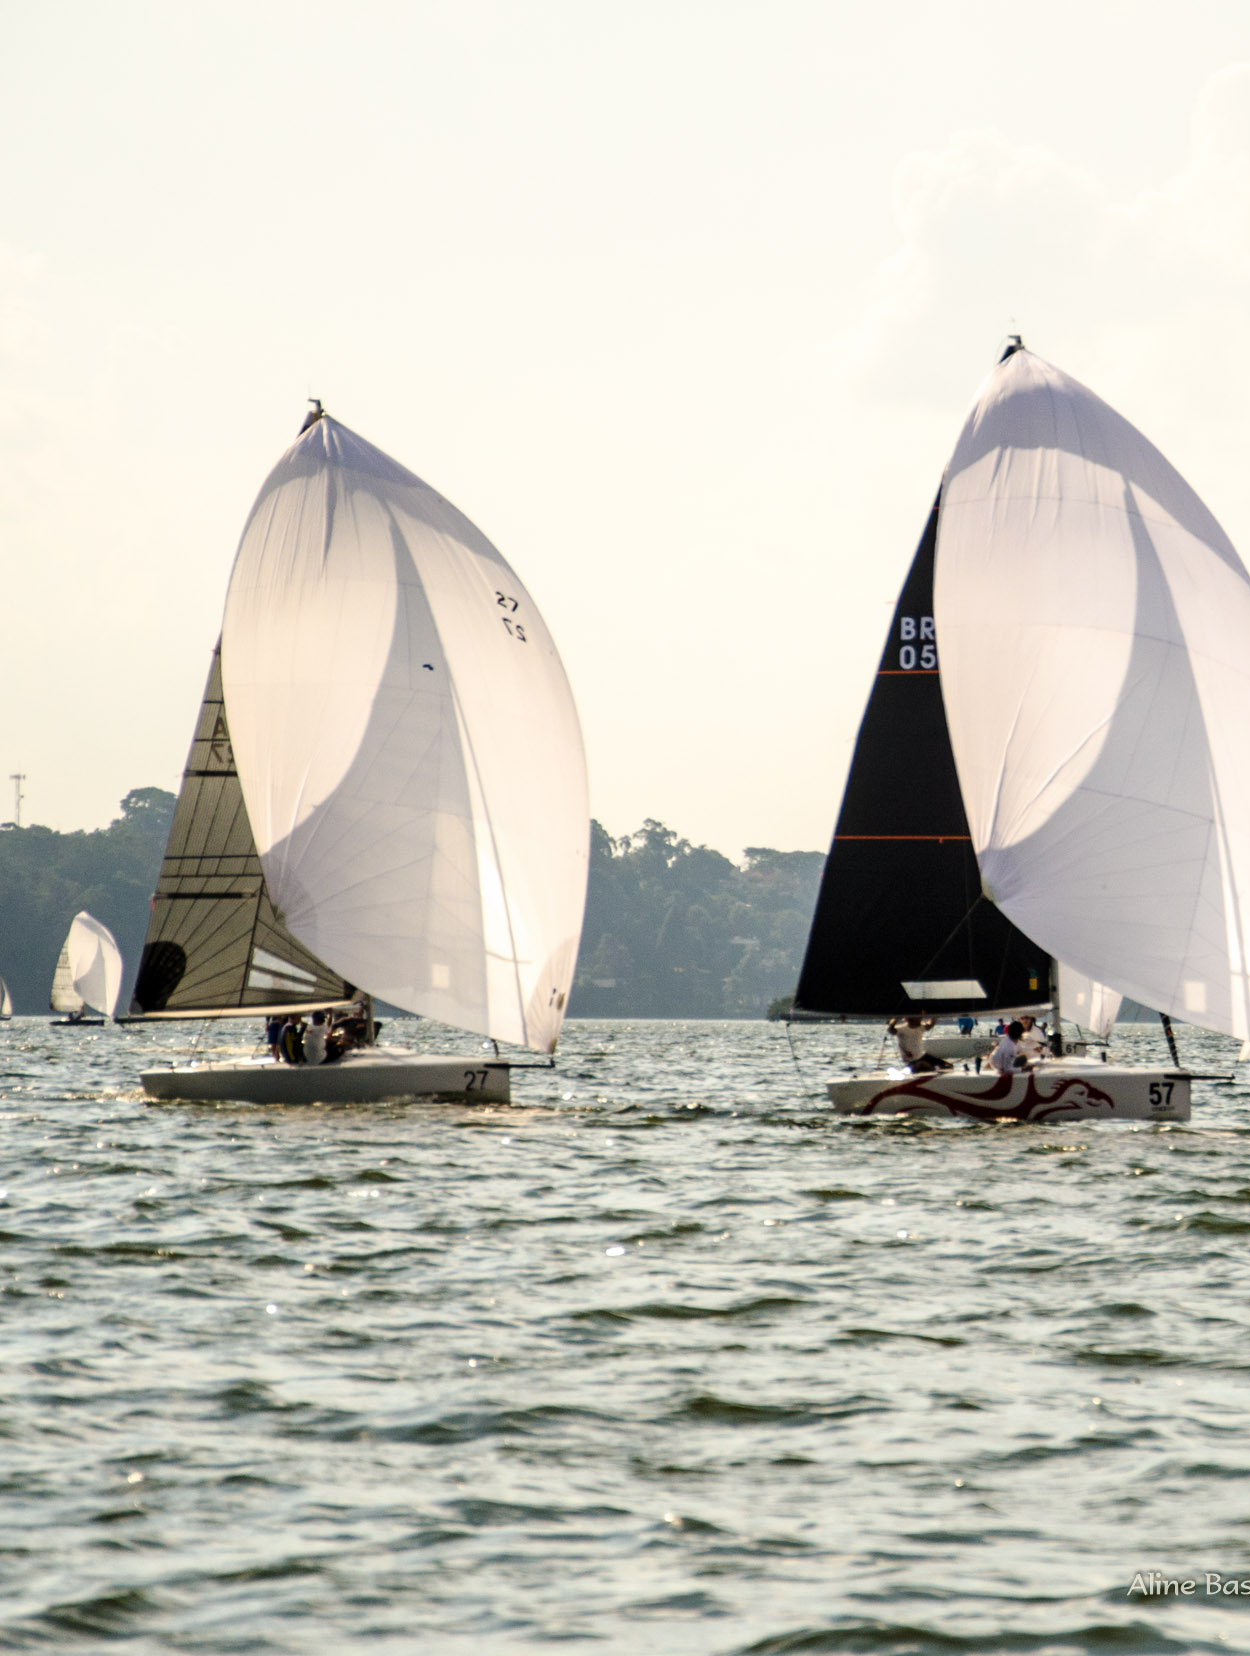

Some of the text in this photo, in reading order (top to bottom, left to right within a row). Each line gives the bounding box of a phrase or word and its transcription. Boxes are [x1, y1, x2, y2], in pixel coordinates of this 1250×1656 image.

[495, 591, 518, 612] 27
[900, 616, 936, 640] BR
[899, 645, 936, 669] 05
[464, 1070, 488, 1092] 27
[1149, 1082, 1174, 1105] 57
